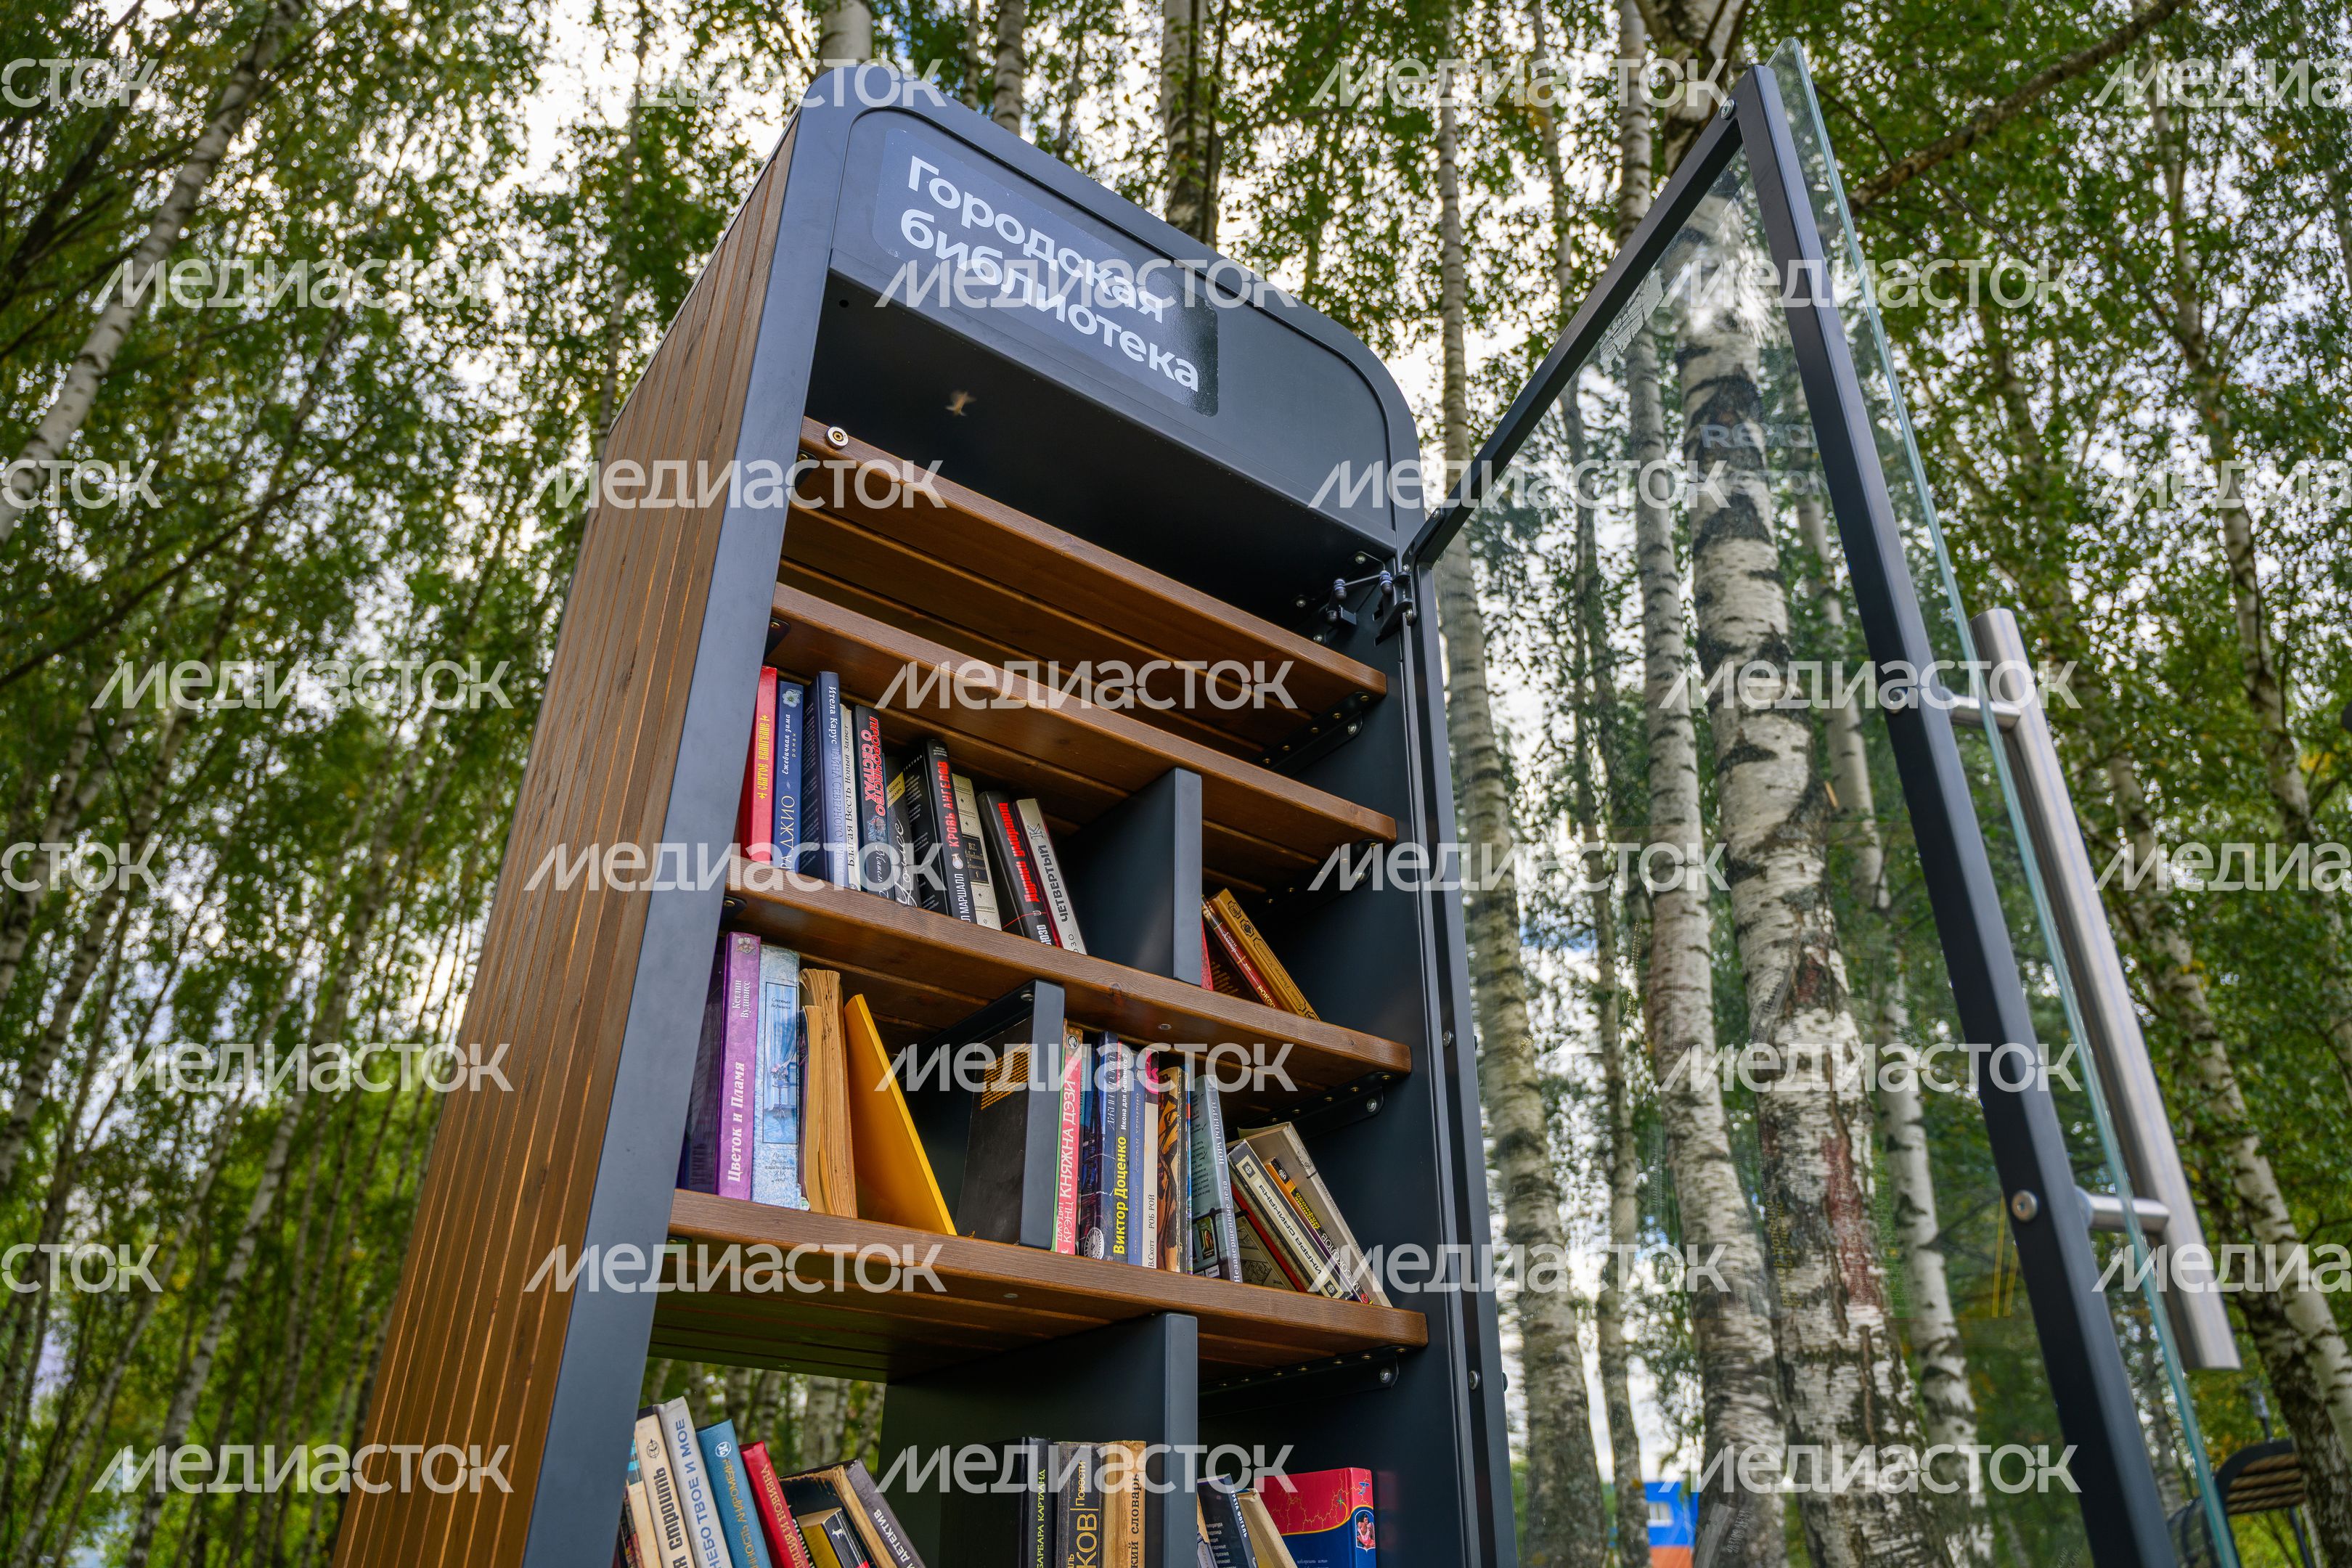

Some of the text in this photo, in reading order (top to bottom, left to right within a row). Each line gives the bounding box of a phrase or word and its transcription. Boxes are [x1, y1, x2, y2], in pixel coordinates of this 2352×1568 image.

[907, 155, 1164, 324] Городская
[900, 207, 1200, 393] библиотека
[828, 686, 837, 715] Итела
[782, 735, 791, 775] Ежевичная
[861, 729, 875, 801] О СЕСТРАХ
[869, 716, 886, 817] ПРОРОЧЕСТВО
[780, 795, 796, 852] ДЖИО
[937, 761, 960, 849] КРОВЬ АНГЕЛОВ
[846, 825, 855, 867] Благая
[1027, 822, 1069, 923] ЧЕТВЕРТЫЙ К
[956, 873, 970, 914] МАРШАЛЛ
[732, 979, 742, 1010] Кетлин
[740, 980, 751, 1018] Вудивисс
[727, 1061, 745, 1182] Цветок и Пламя
[1062, 1080, 1077, 1126] ДЭЗИ
[1210, 1098, 1222, 1140] РОБЕРТС
[1059, 1129, 1075, 1199] КНЯЖНА
[1063, 1201, 1074, 1244] КРЭНЦ
[1114, 1136, 1129, 1255] Виктор Доценко
[1225, 1204, 1240, 1283] Незавершенные
[1294, 1236, 1322, 1275] ИХАРА
[1320, 1231, 1352, 1279] СОКОЛОВ
[654, 1466, 682, 1551] строить
[675, 1418, 721, 1568] НЕБО ТВОЕ И МОЕ
[760, 1465, 785, 1521] НОВИЗНА
[1075, 1460, 1087, 1506] Повести
[1130, 1473, 1142, 1535] словарь
[873, 1508, 911, 1562] ДЕТЕКТИВ
[1036, 1469, 1046, 1568] БАРБАРА КАРТЛАНД
[1230, 1489, 1248, 1539] ГРЕТА ФОГЕЛЬ
